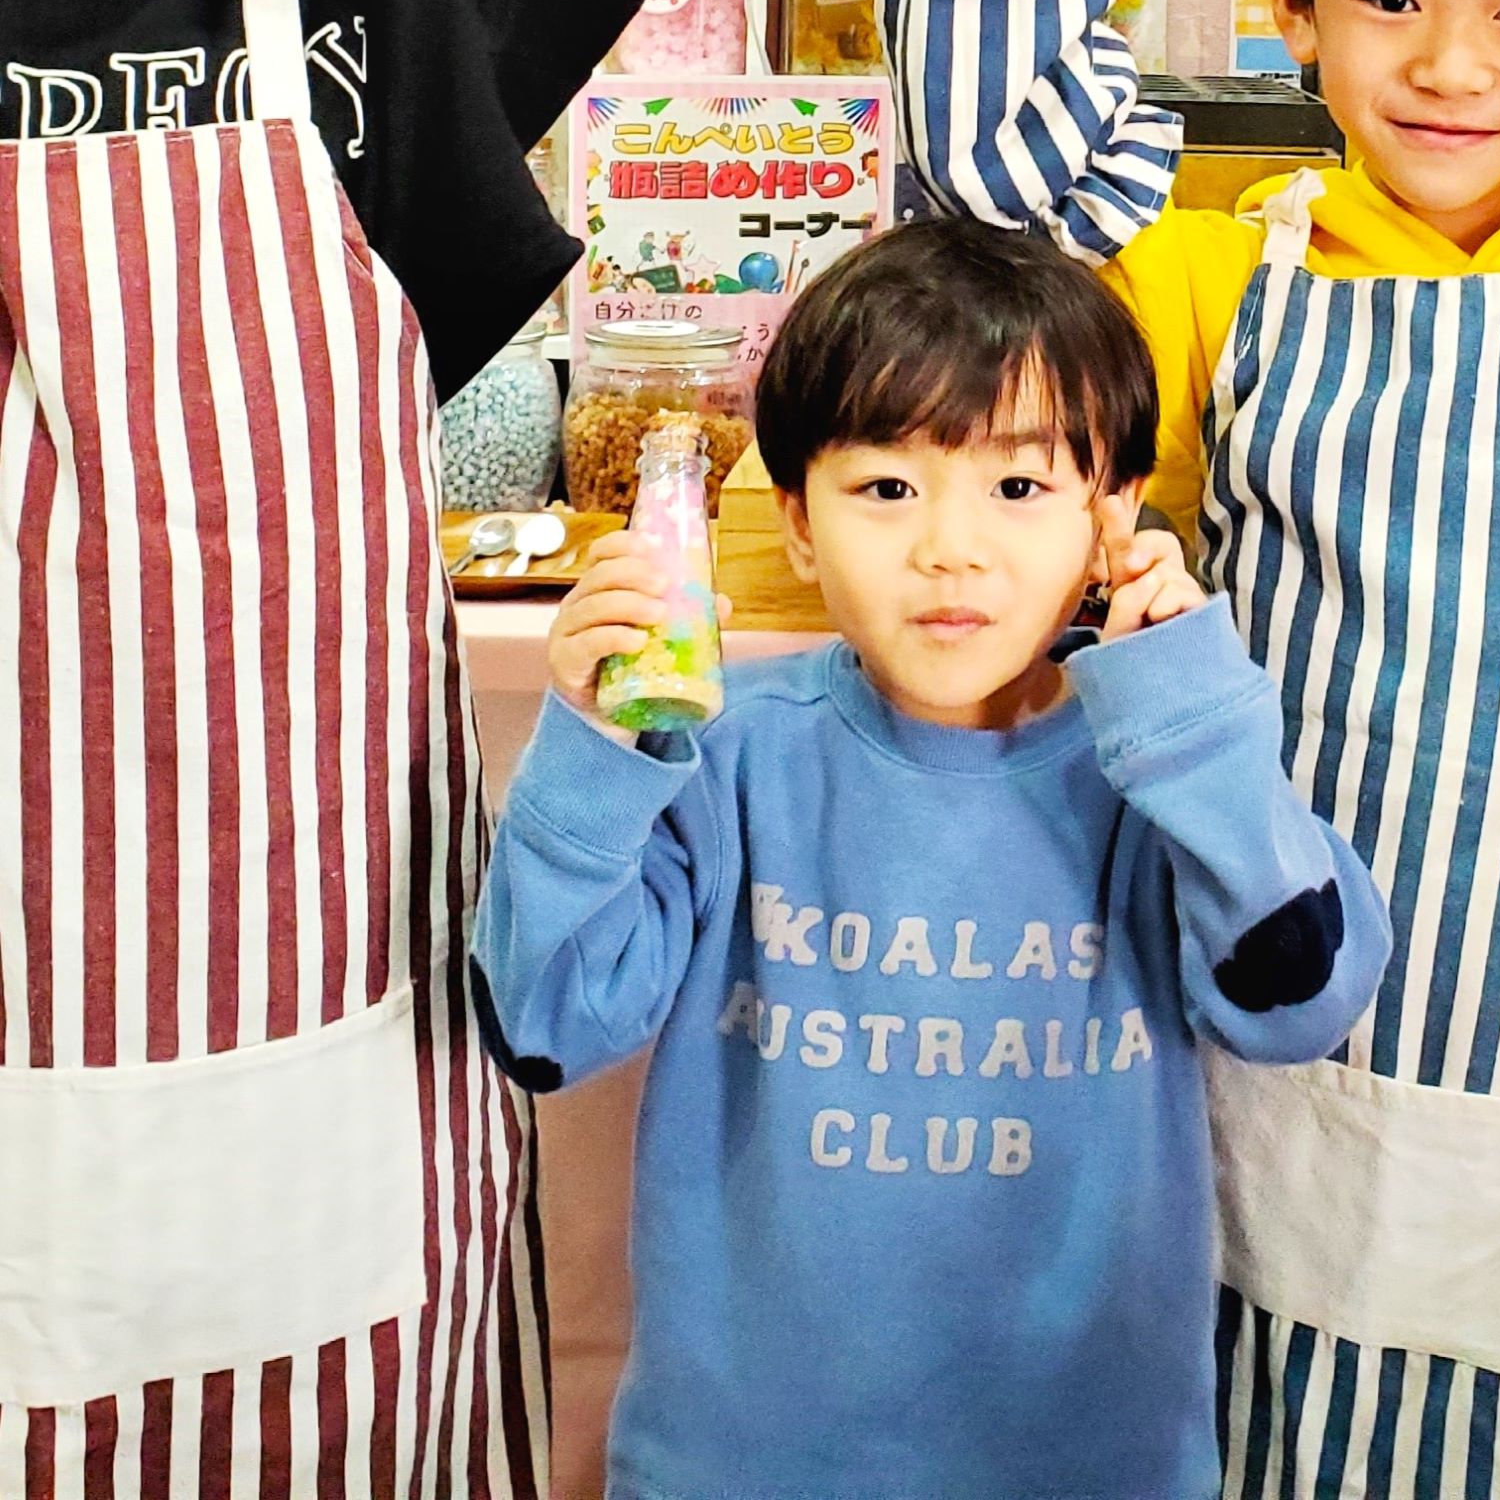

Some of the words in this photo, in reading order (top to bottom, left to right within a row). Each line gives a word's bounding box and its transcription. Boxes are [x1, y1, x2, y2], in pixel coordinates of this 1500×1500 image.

[611, 121, 855, 155] こんぺいとう
[608, 160, 855, 200] 瓶詰め作り
[739, 211, 872, 238] コーナー
[718, 981, 1153, 1079] AUSTRALIA
[810, 1108, 1032, 1176] CLUB
